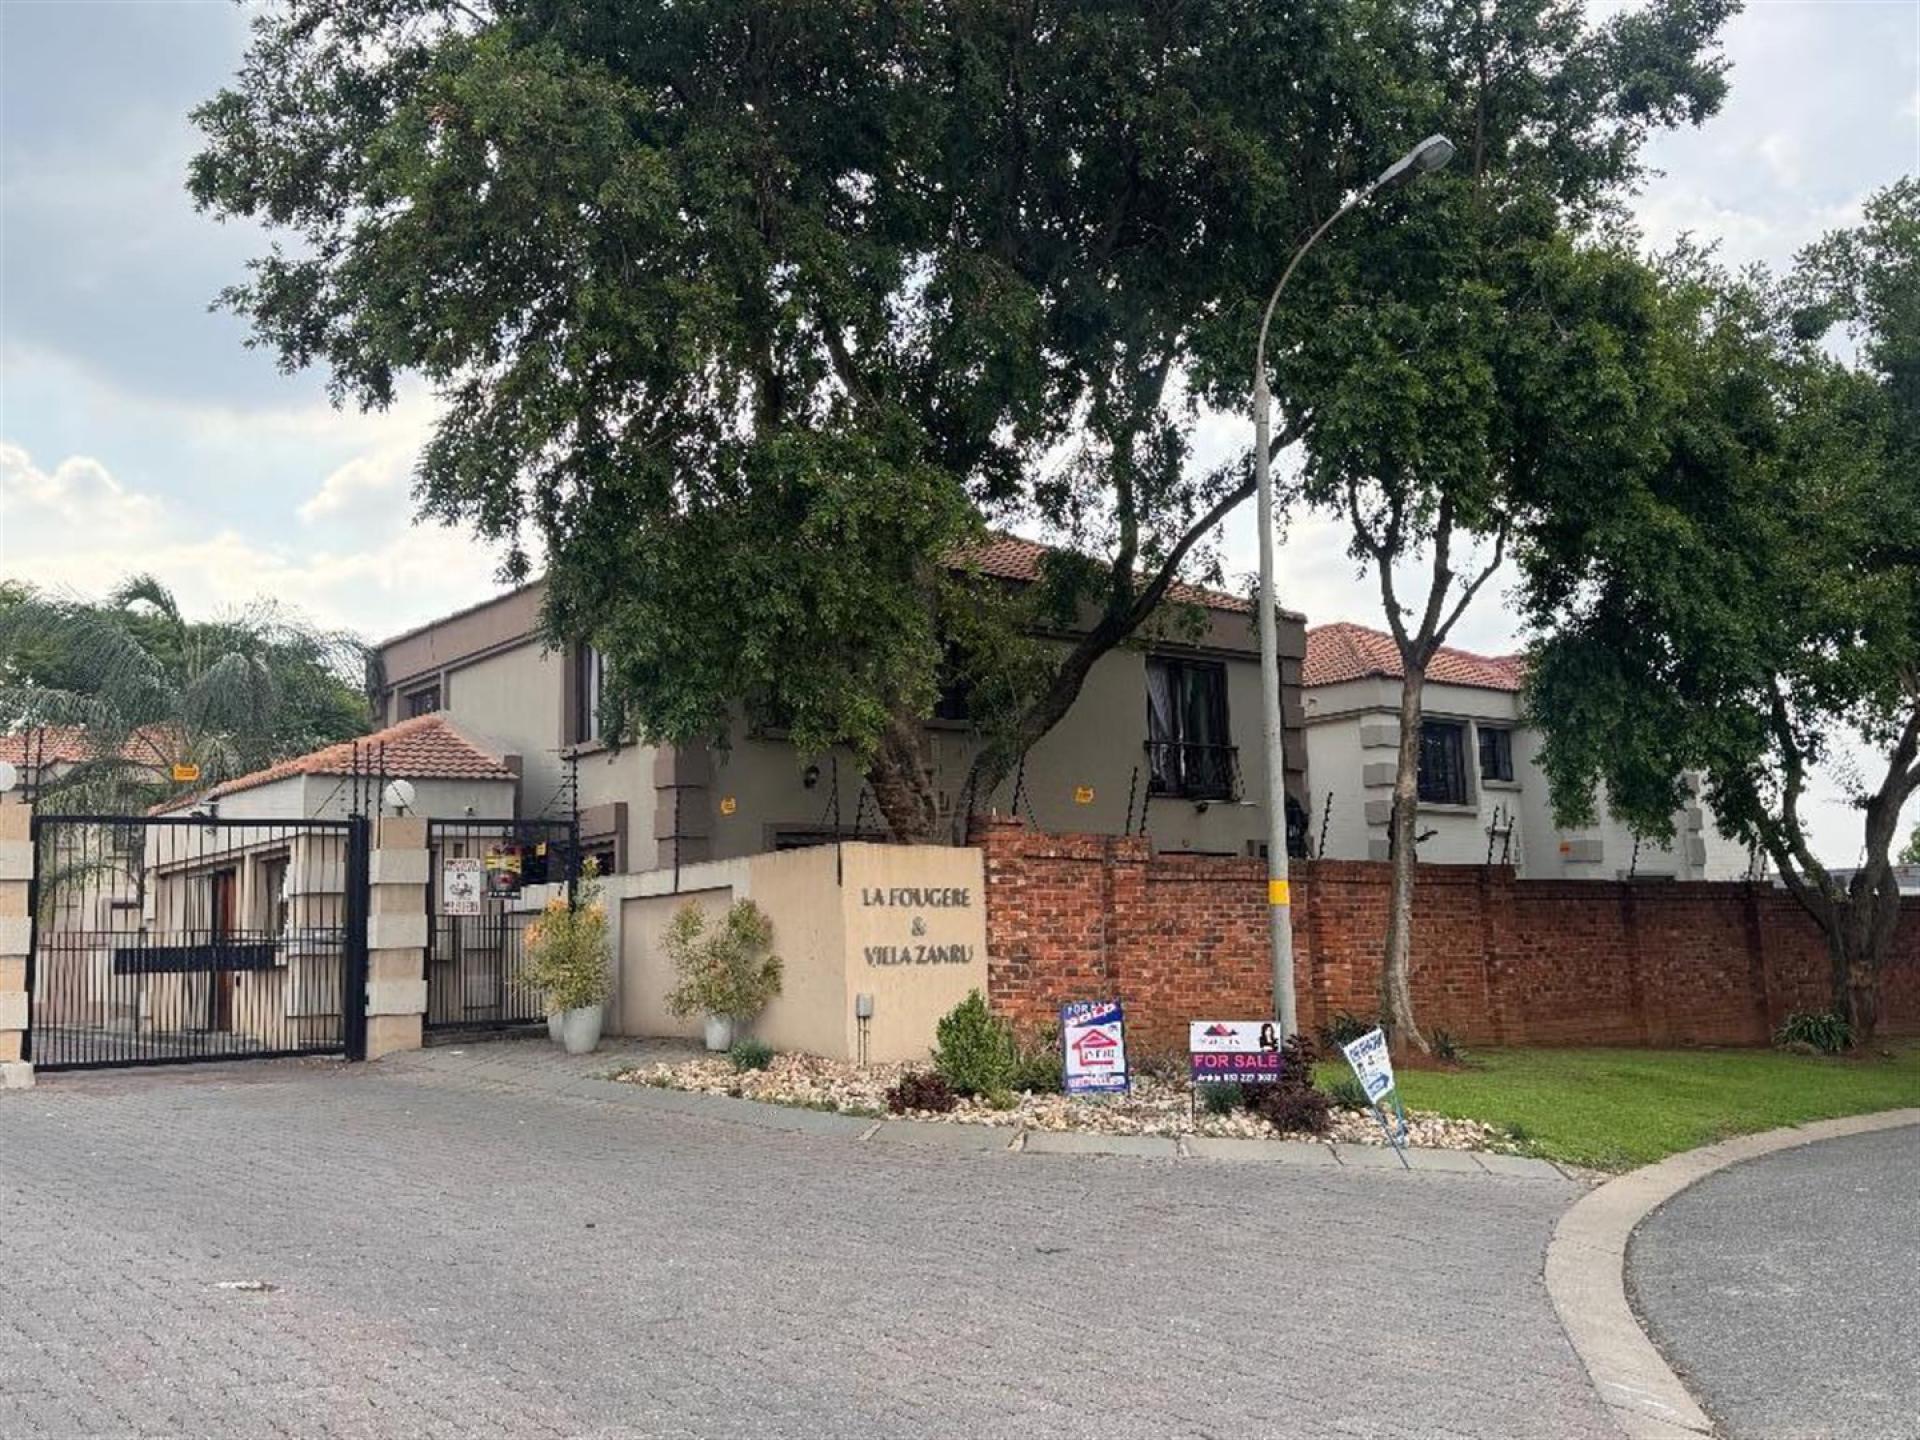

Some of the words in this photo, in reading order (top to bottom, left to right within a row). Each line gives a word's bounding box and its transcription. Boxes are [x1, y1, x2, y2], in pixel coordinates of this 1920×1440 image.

[862, 887, 885, 907] LA
[889, 887, 972, 908] FOUGERE
[911, 915, 927, 937] &
[863, 945, 912, 967] VILLA
[914, 943, 974, 966] ZANRU
[1193, 1054, 1229, 1068] FOR
[1234, 1054, 1279, 1068] SALE
